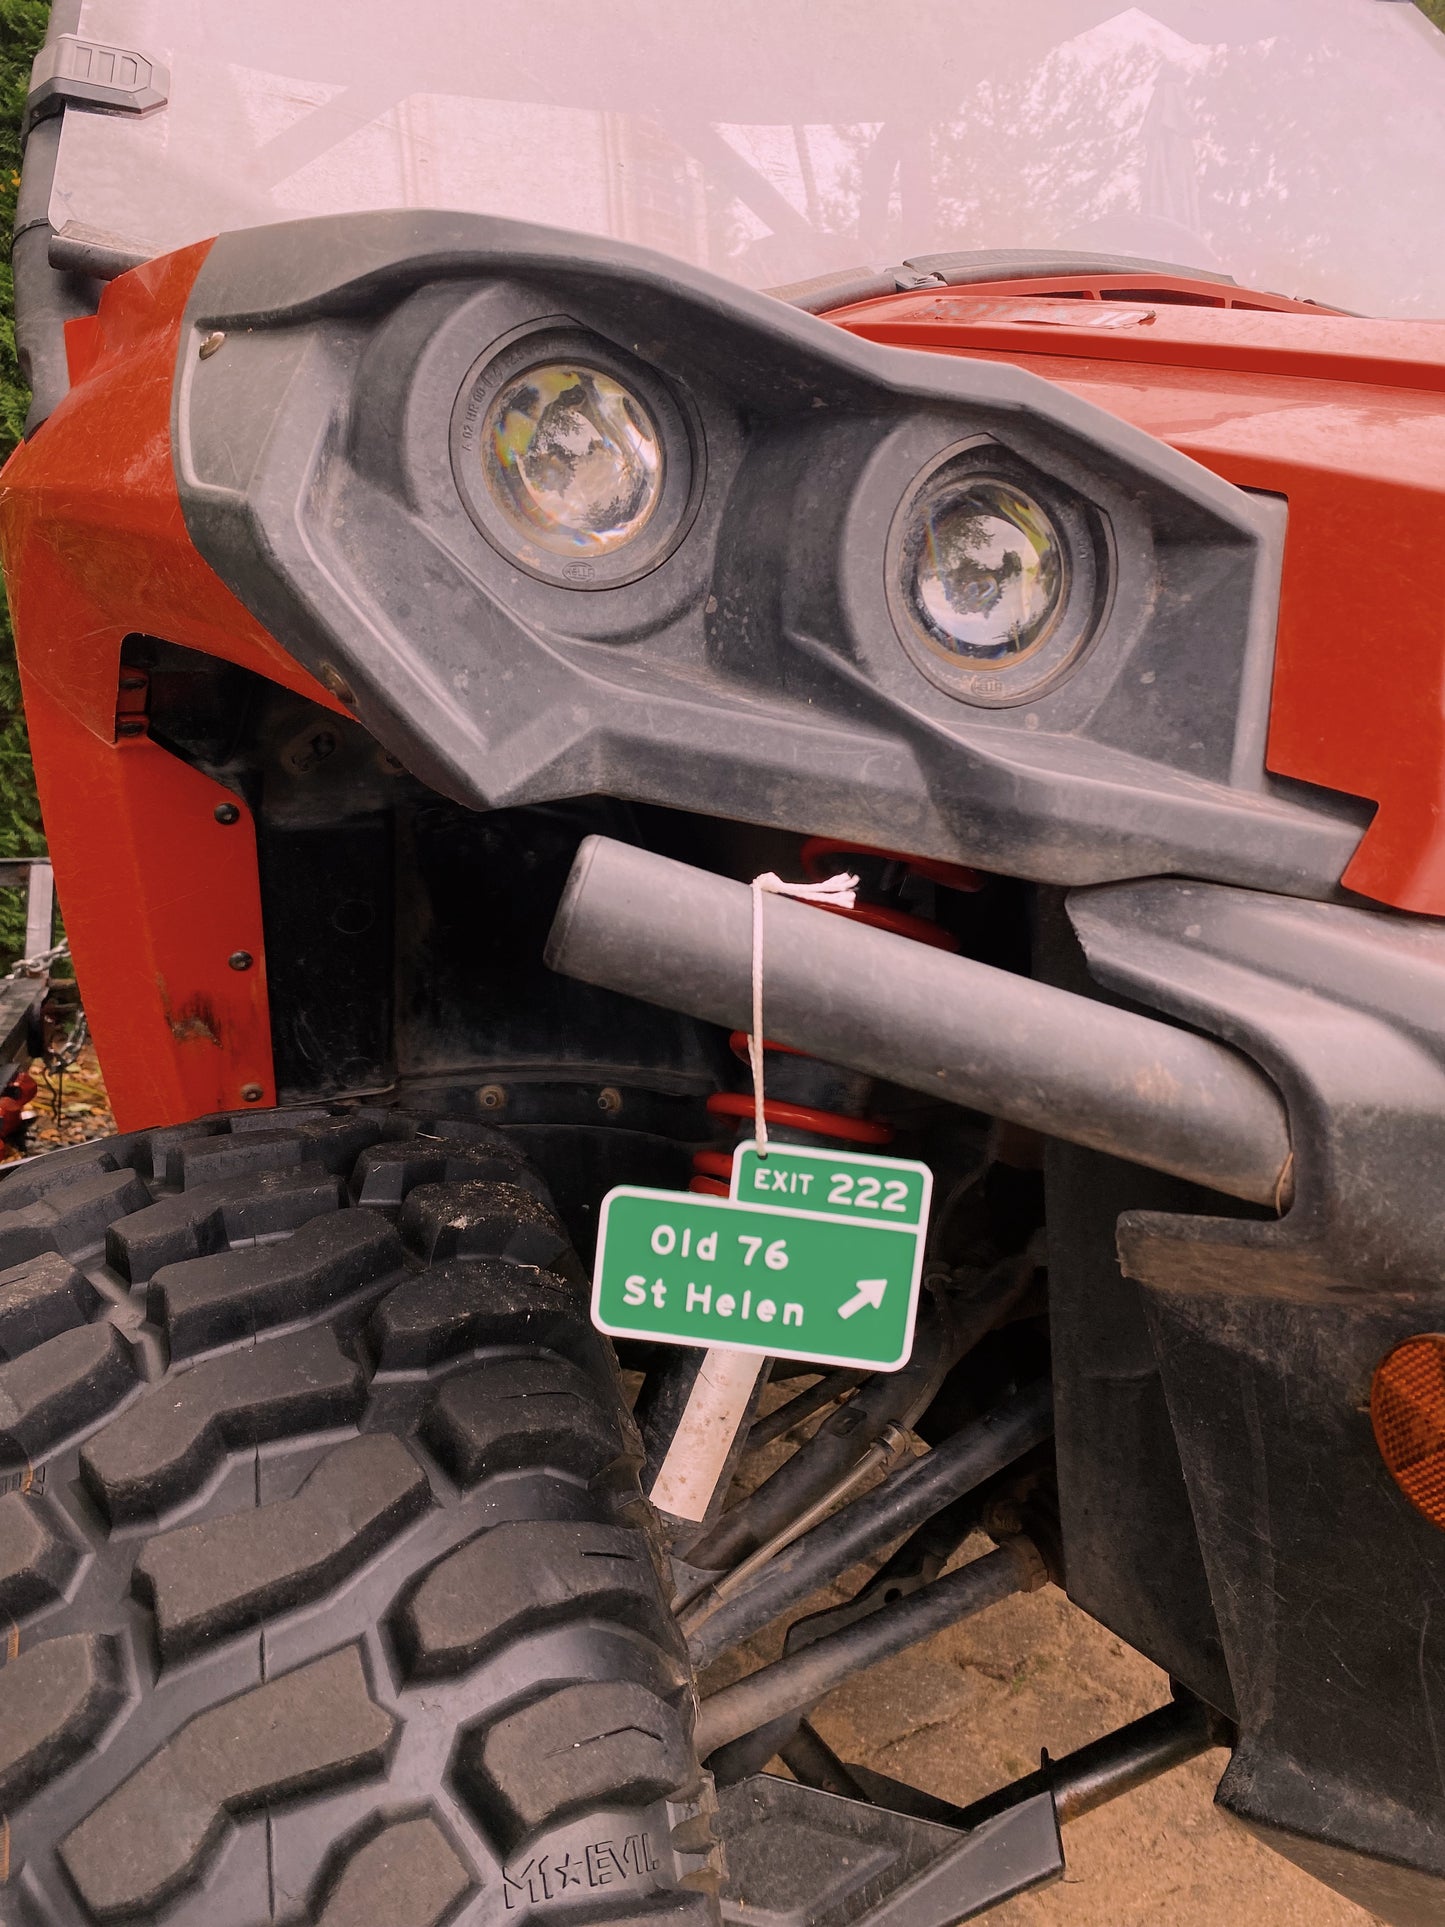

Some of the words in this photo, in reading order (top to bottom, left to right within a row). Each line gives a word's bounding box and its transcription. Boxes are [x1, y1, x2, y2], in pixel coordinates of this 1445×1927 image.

[754, 1167, 814, 1195] EXIT
[827, 1173, 909, 1213] 222
[650, 1224, 718, 1262] Old
[737, 1235, 789, 1271] 76
[622, 1274, 667, 1309] St
[685, 1282, 804, 1327] Helen
[585, 1832, 659, 1888] EVIL
